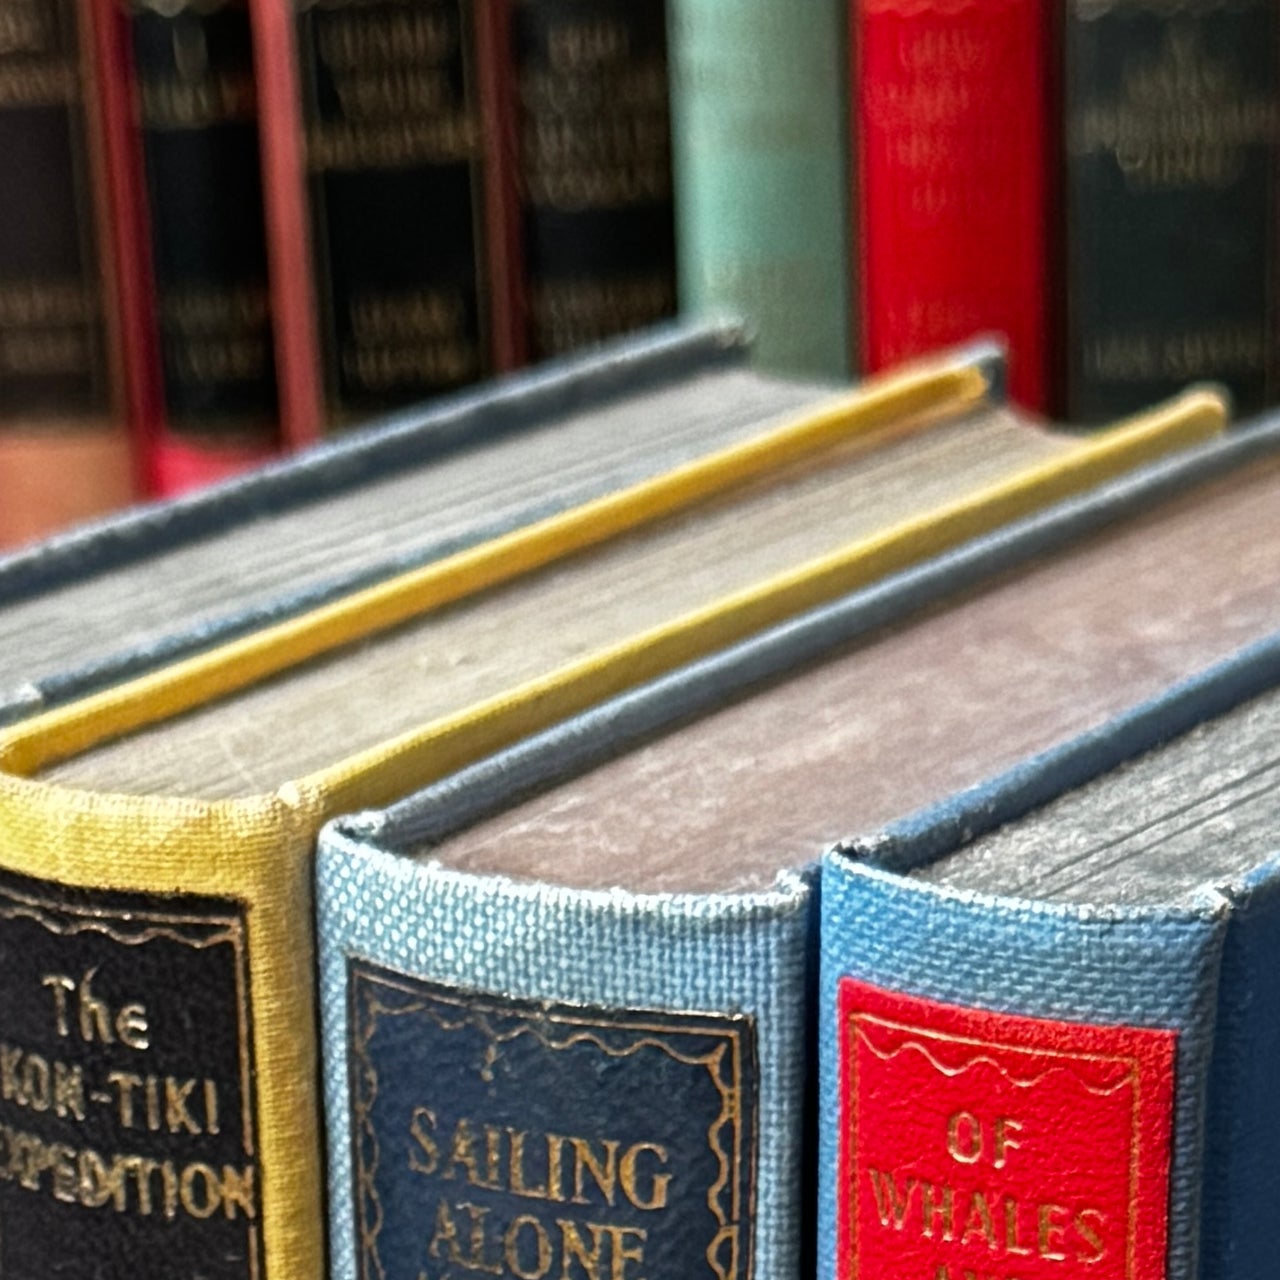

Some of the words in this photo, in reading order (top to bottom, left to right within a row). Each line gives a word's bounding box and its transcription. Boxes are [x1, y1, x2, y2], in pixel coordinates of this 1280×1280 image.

[42, 962, 149, 1050] The
[0, 1043, 220, 1135] KON-TIKI
[408, 1105, 673, 1210] SAILING
[947, 1110, 1024, 1169] OF
[869, 1167, 1108, 1264] WHALES
